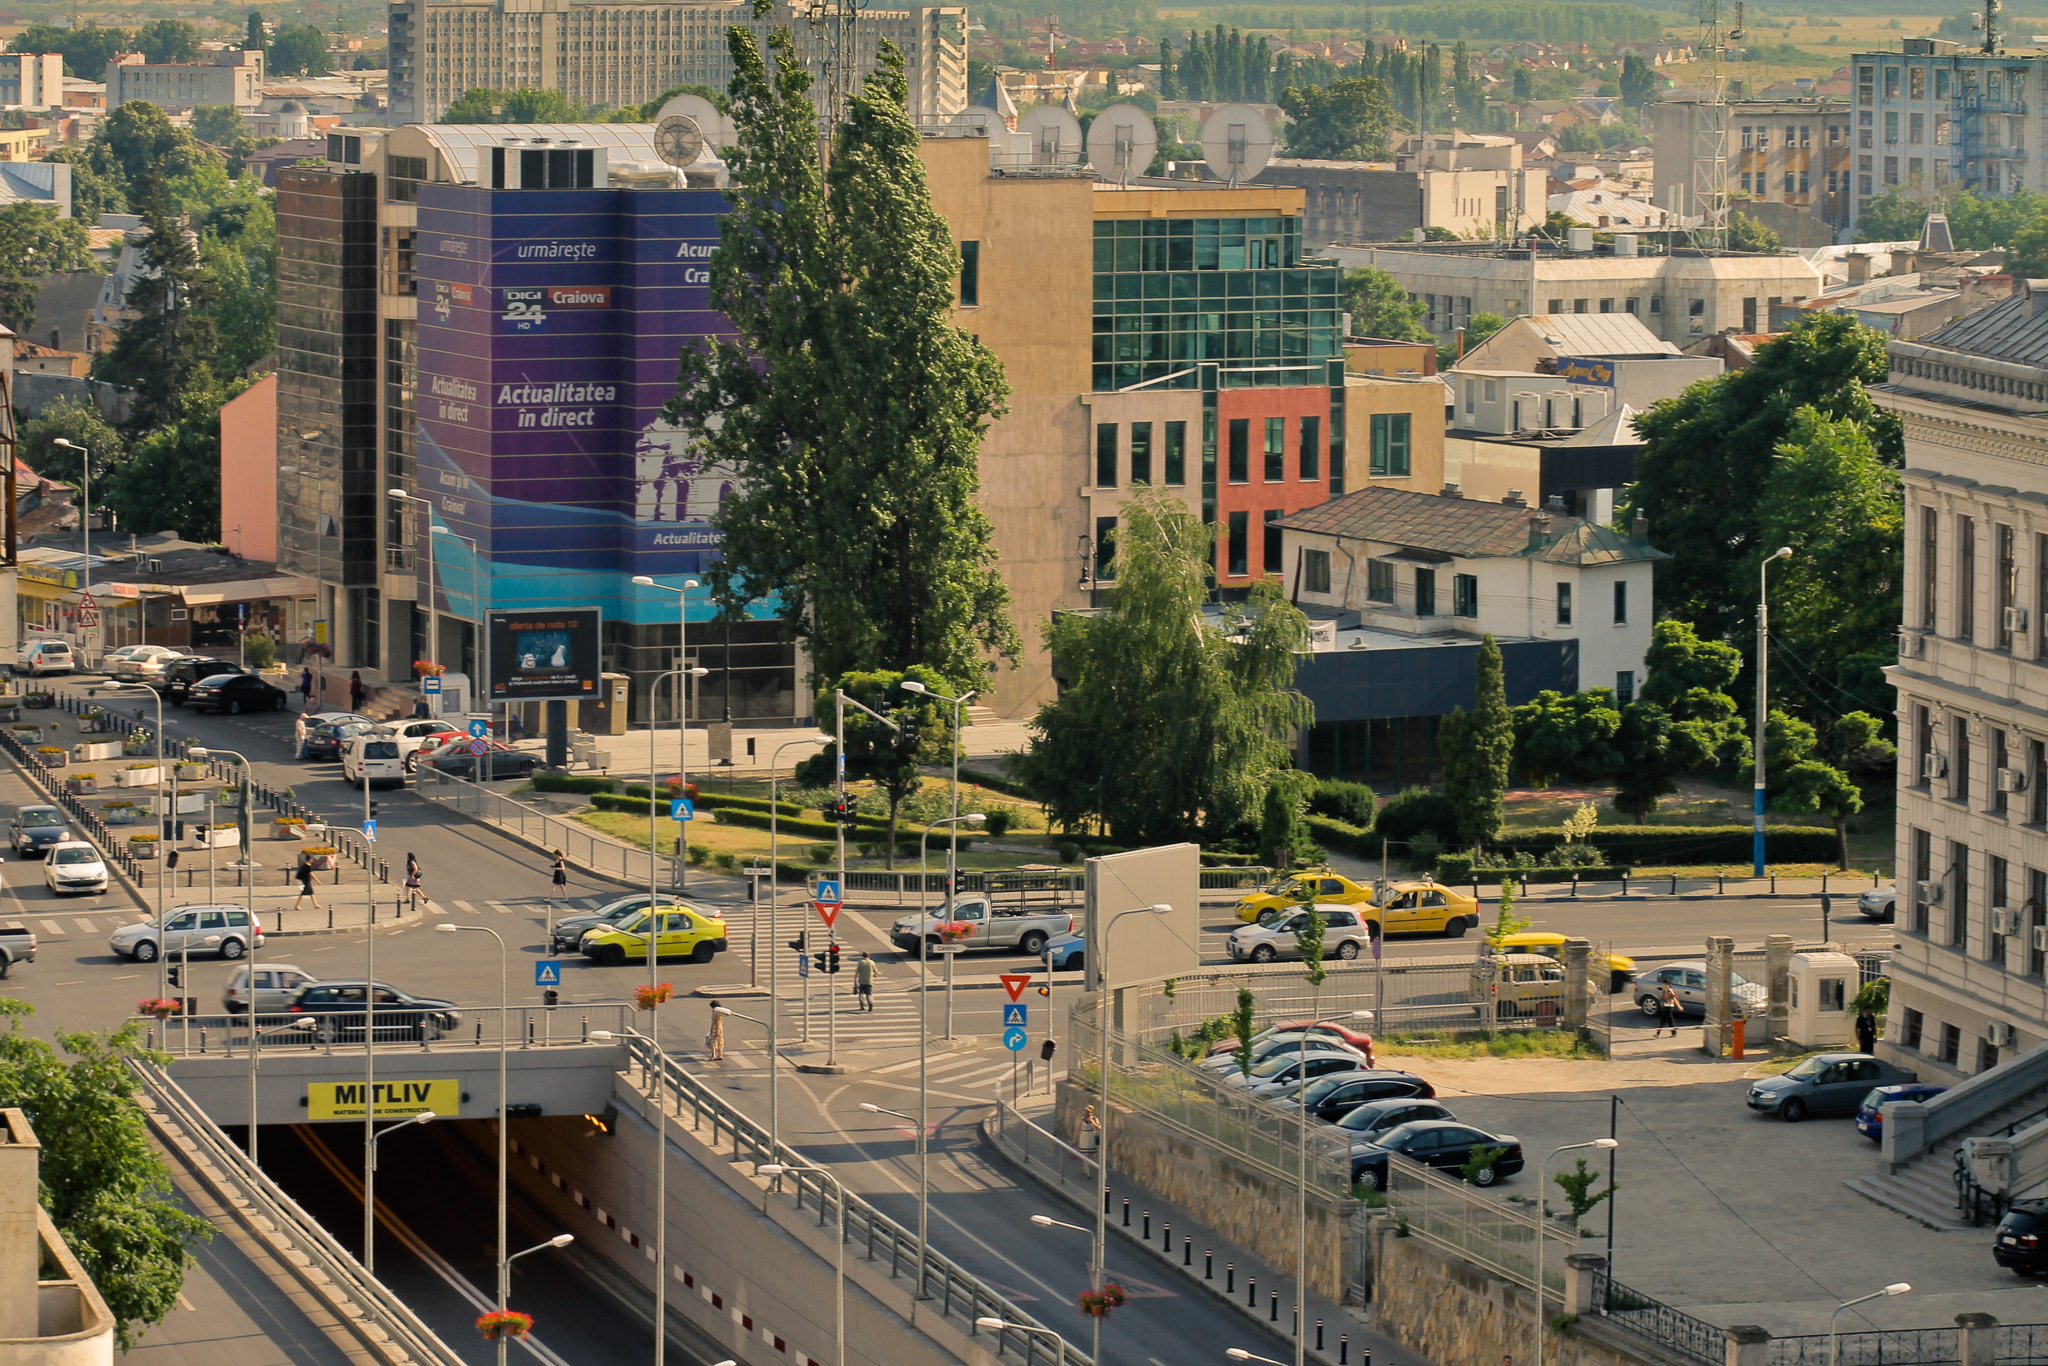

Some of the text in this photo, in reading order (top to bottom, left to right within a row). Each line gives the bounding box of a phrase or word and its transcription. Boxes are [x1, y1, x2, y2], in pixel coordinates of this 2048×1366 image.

[507, 291, 542, 300] DIGI
[552, 290, 605, 304] Craiova
[502, 301, 547, 325] 24
[517, 322, 531, 330] HD
[431, 375, 477, 401] Actualitatea
[497, 382, 616, 405] Actualitatea
[518, 407, 595, 427] în direct
[567, 620, 578, 629] 10
[335, 1083, 431, 1104] MITLIV
